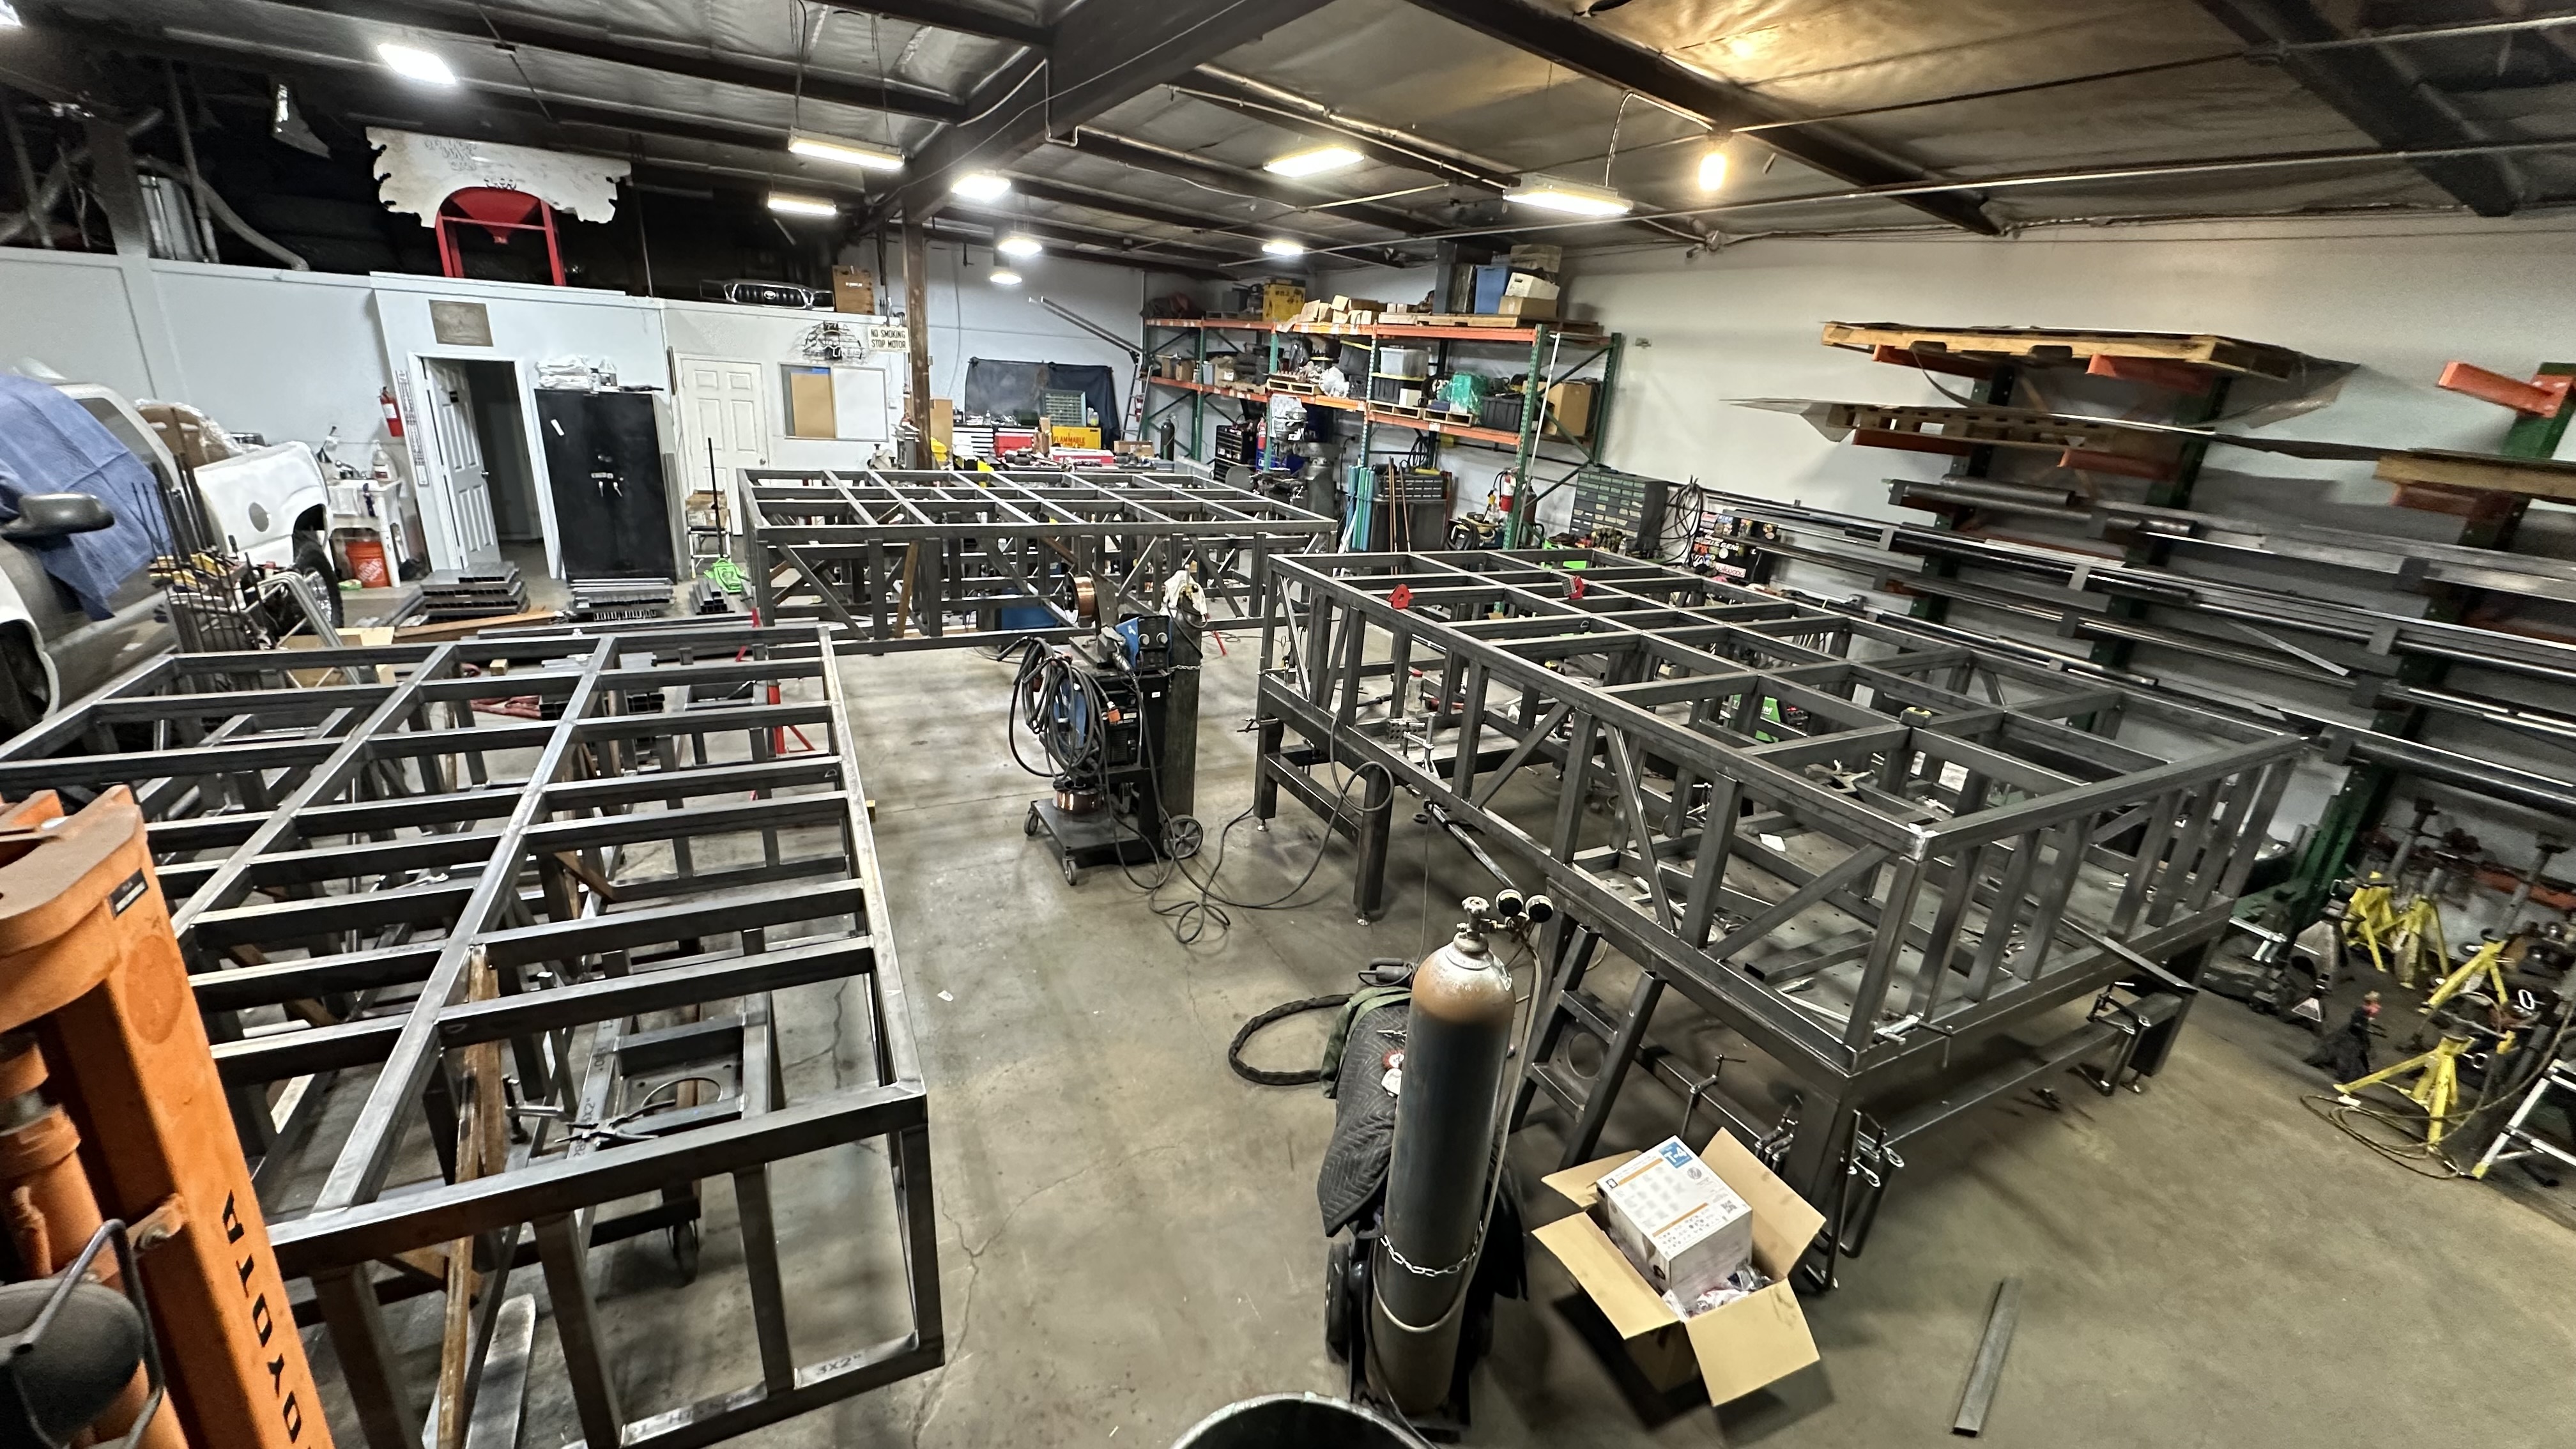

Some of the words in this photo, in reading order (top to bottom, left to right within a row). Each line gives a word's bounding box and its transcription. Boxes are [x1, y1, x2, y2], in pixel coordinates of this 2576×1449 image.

[871, 329, 878, 337] NO
[881, 330, 906, 339] SMOKING
[871, 339, 885, 348] STOP
[888, 340, 907, 349] MOTOR
[1054, 435, 1085, 443] FLAMMABLE
[1664, 1146, 1687, 1163] T-4
[222, 1189, 313, 1449] OYOTA
